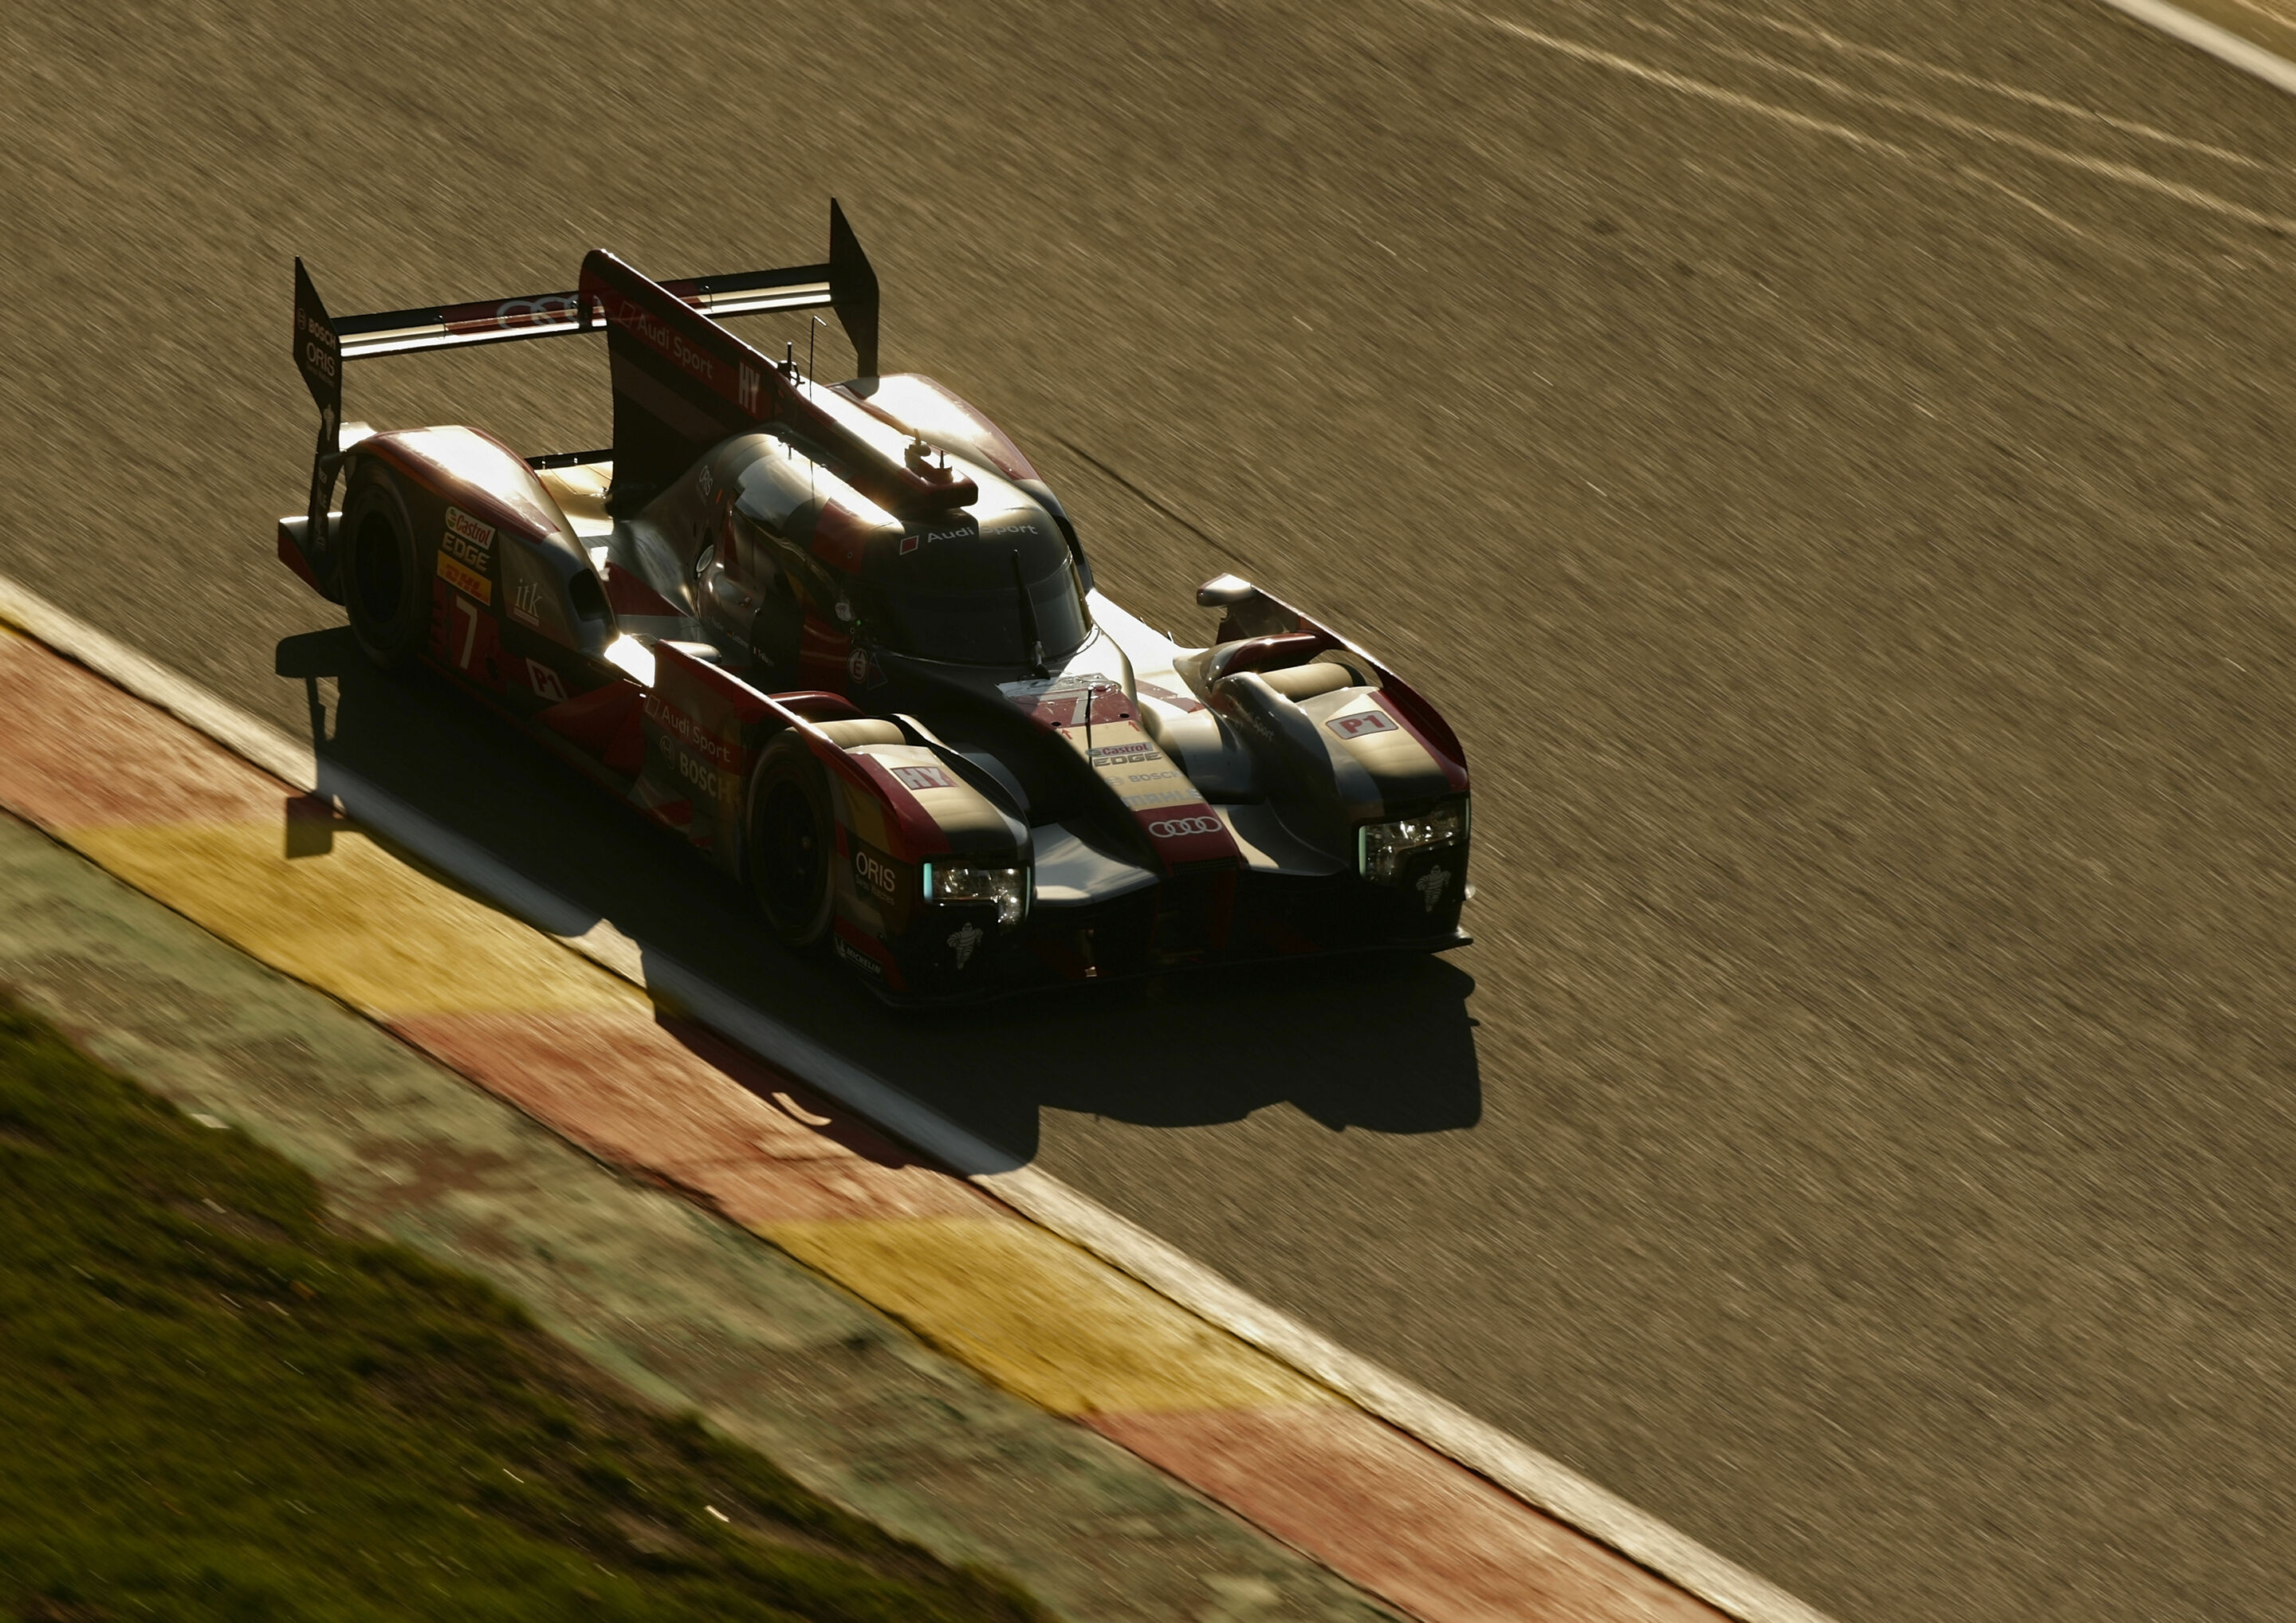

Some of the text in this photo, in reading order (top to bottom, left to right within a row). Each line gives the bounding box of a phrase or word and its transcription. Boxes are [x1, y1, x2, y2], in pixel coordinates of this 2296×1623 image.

[309, 317, 336, 350] BOSCH
[638, 312, 714, 380] Audi Sport
[306, 341, 335, 377] ORIS
[738, 361, 761, 415] HY
[456, 515, 490, 546] Castrol
[927, 524, 1039, 544] Audi Sport
[442, 532, 491, 572] EDGE
[515, 578, 543, 619] itk
[456, 594, 478, 670] 7
[533, 665, 564, 701] P1
[1039, 688, 1091, 725] 7
[1339, 714, 1386, 734] P1
[662, 705, 732, 763] Audi Sport
[1102, 742, 1149, 756] Castrol
[893, 767, 949, 789] HY
[1093, 752, 1163, 768] EDGE
[1128, 771, 1184, 783] BOSCH
[680, 753, 733, 804] BOSCH
[1120, 788, 1202, 808] MAHLE
[855, 851, 896, 893] ORIS
[847, 946, 881, 975] MICHELIN
